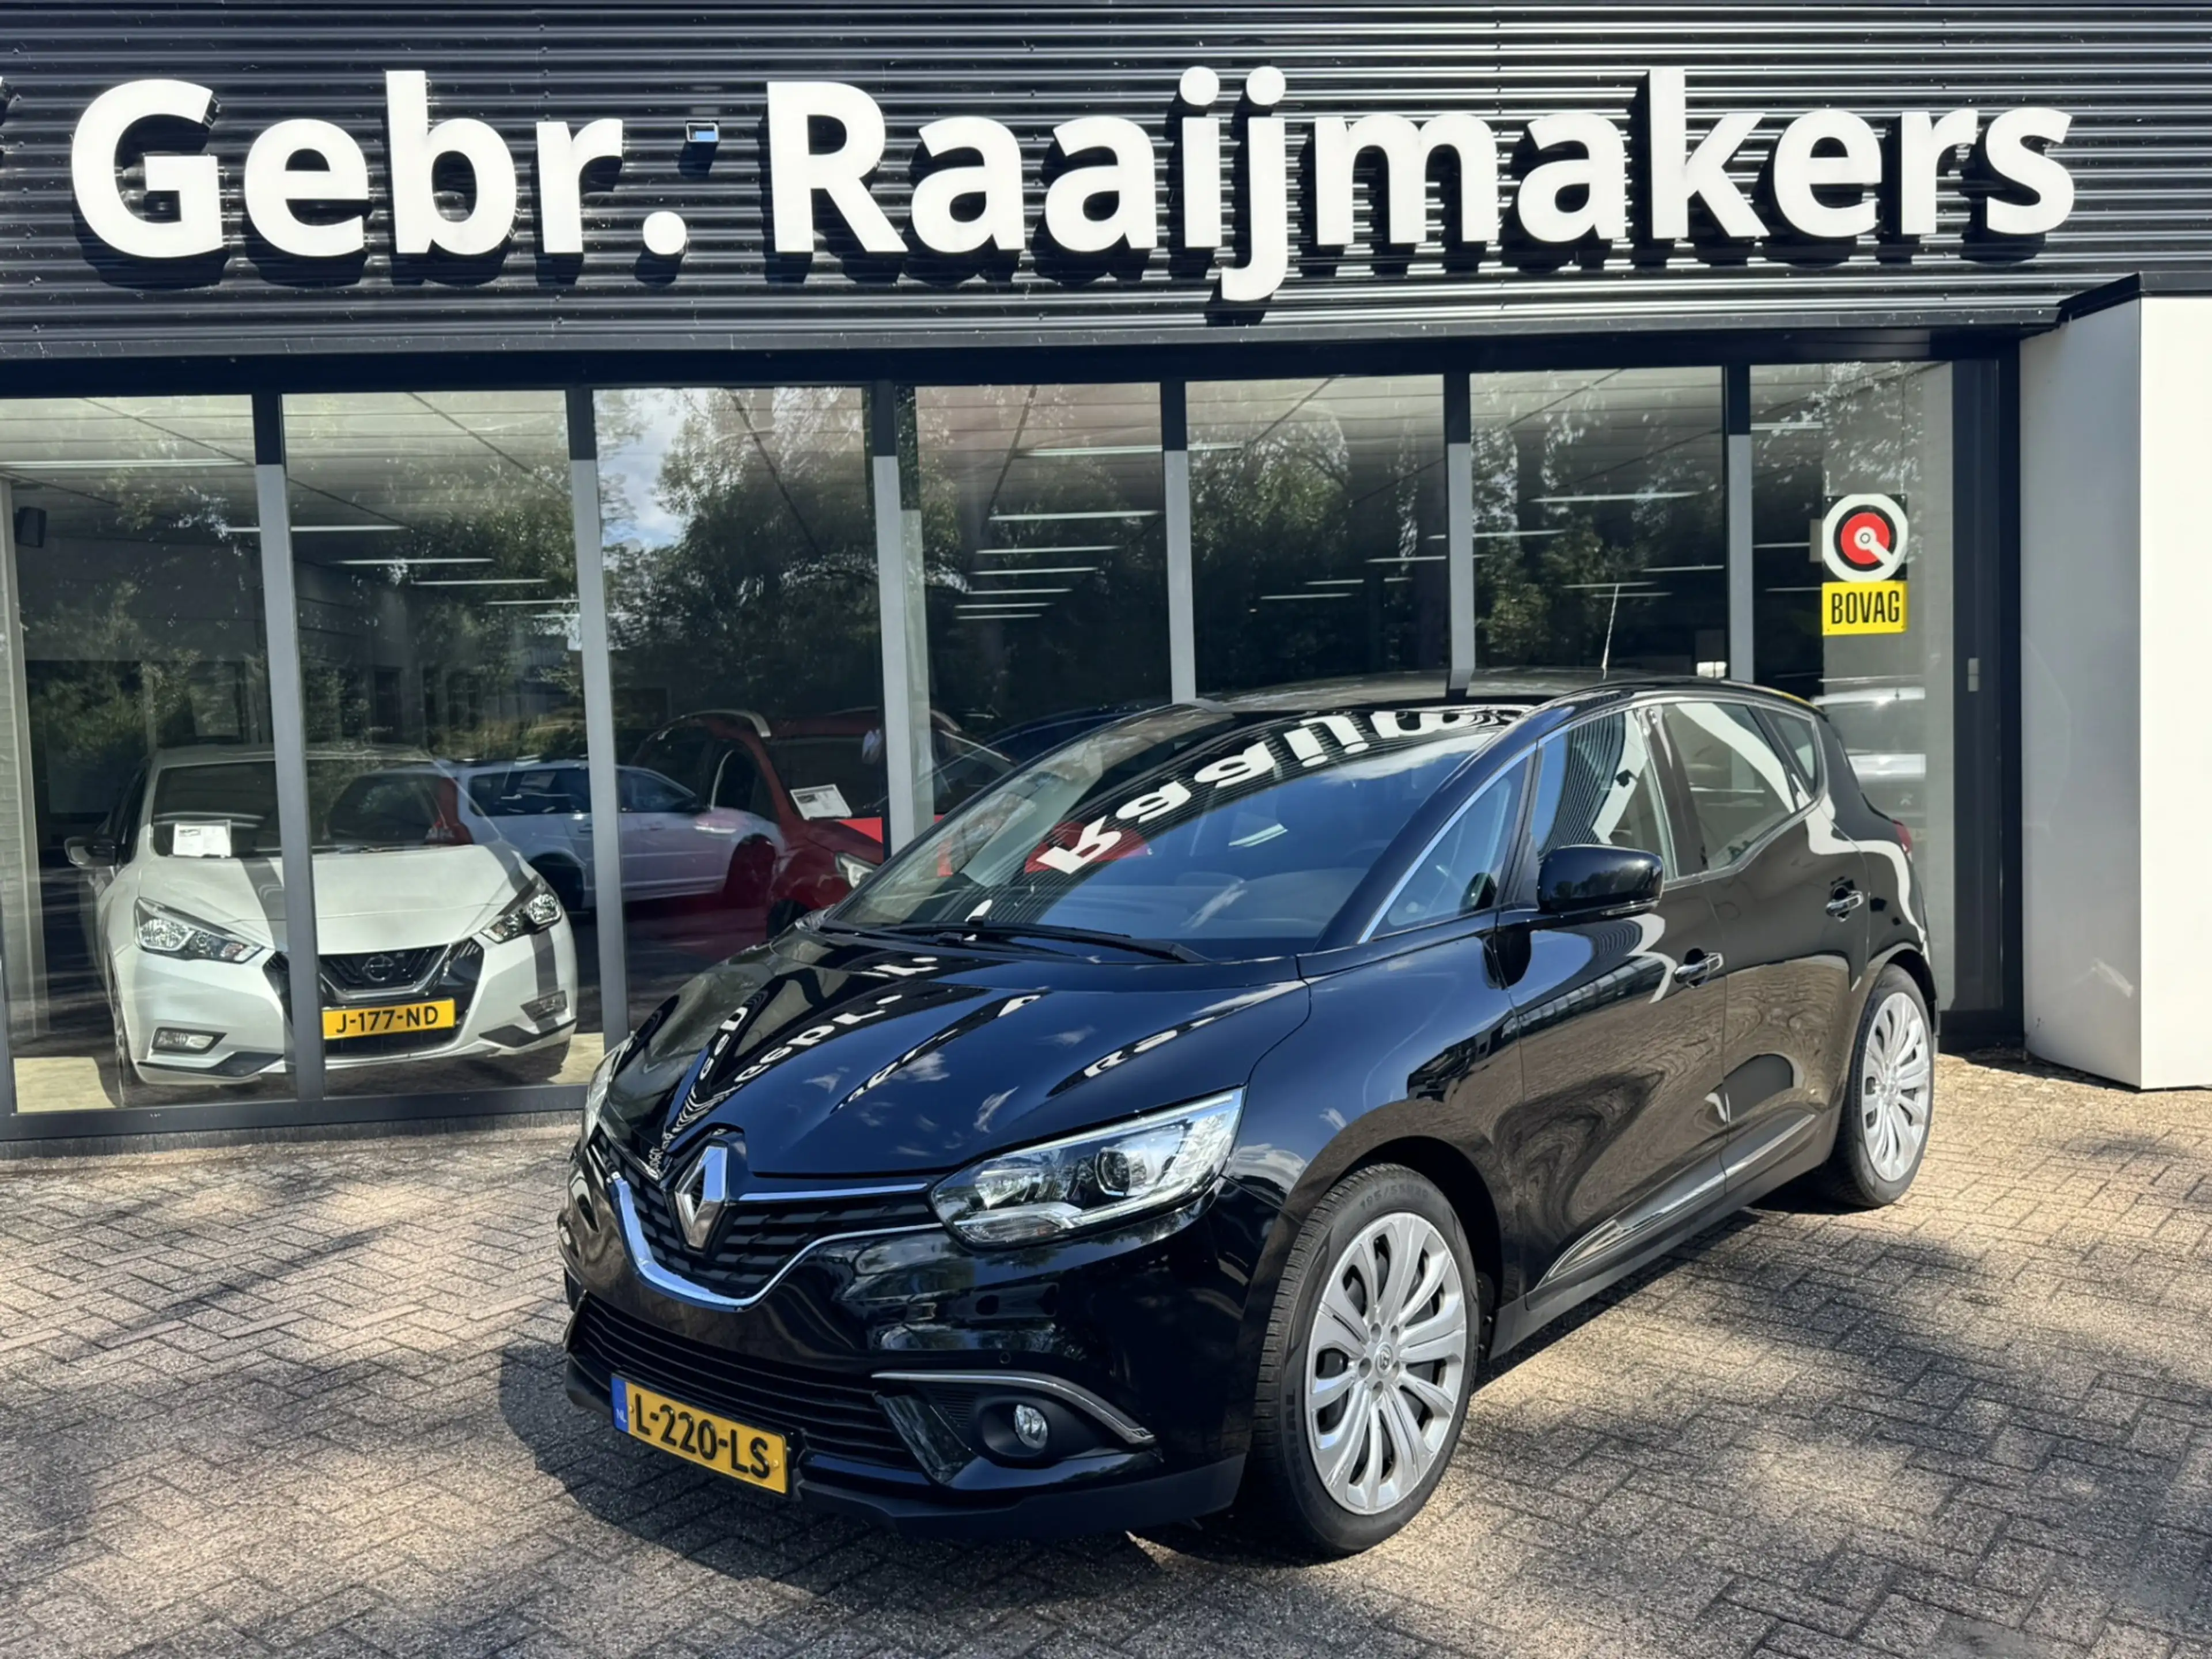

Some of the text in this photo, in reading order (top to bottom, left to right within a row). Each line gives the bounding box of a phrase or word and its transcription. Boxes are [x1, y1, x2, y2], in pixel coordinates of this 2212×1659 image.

[71, 66, 2075, 301] Gebr. Raaijmakers
[1831, 590, 1900, 624] BOVAG
[336, 1005, 438, 1033] J-177-ND
[634, 1393, 770, 1479] L-220-LS
